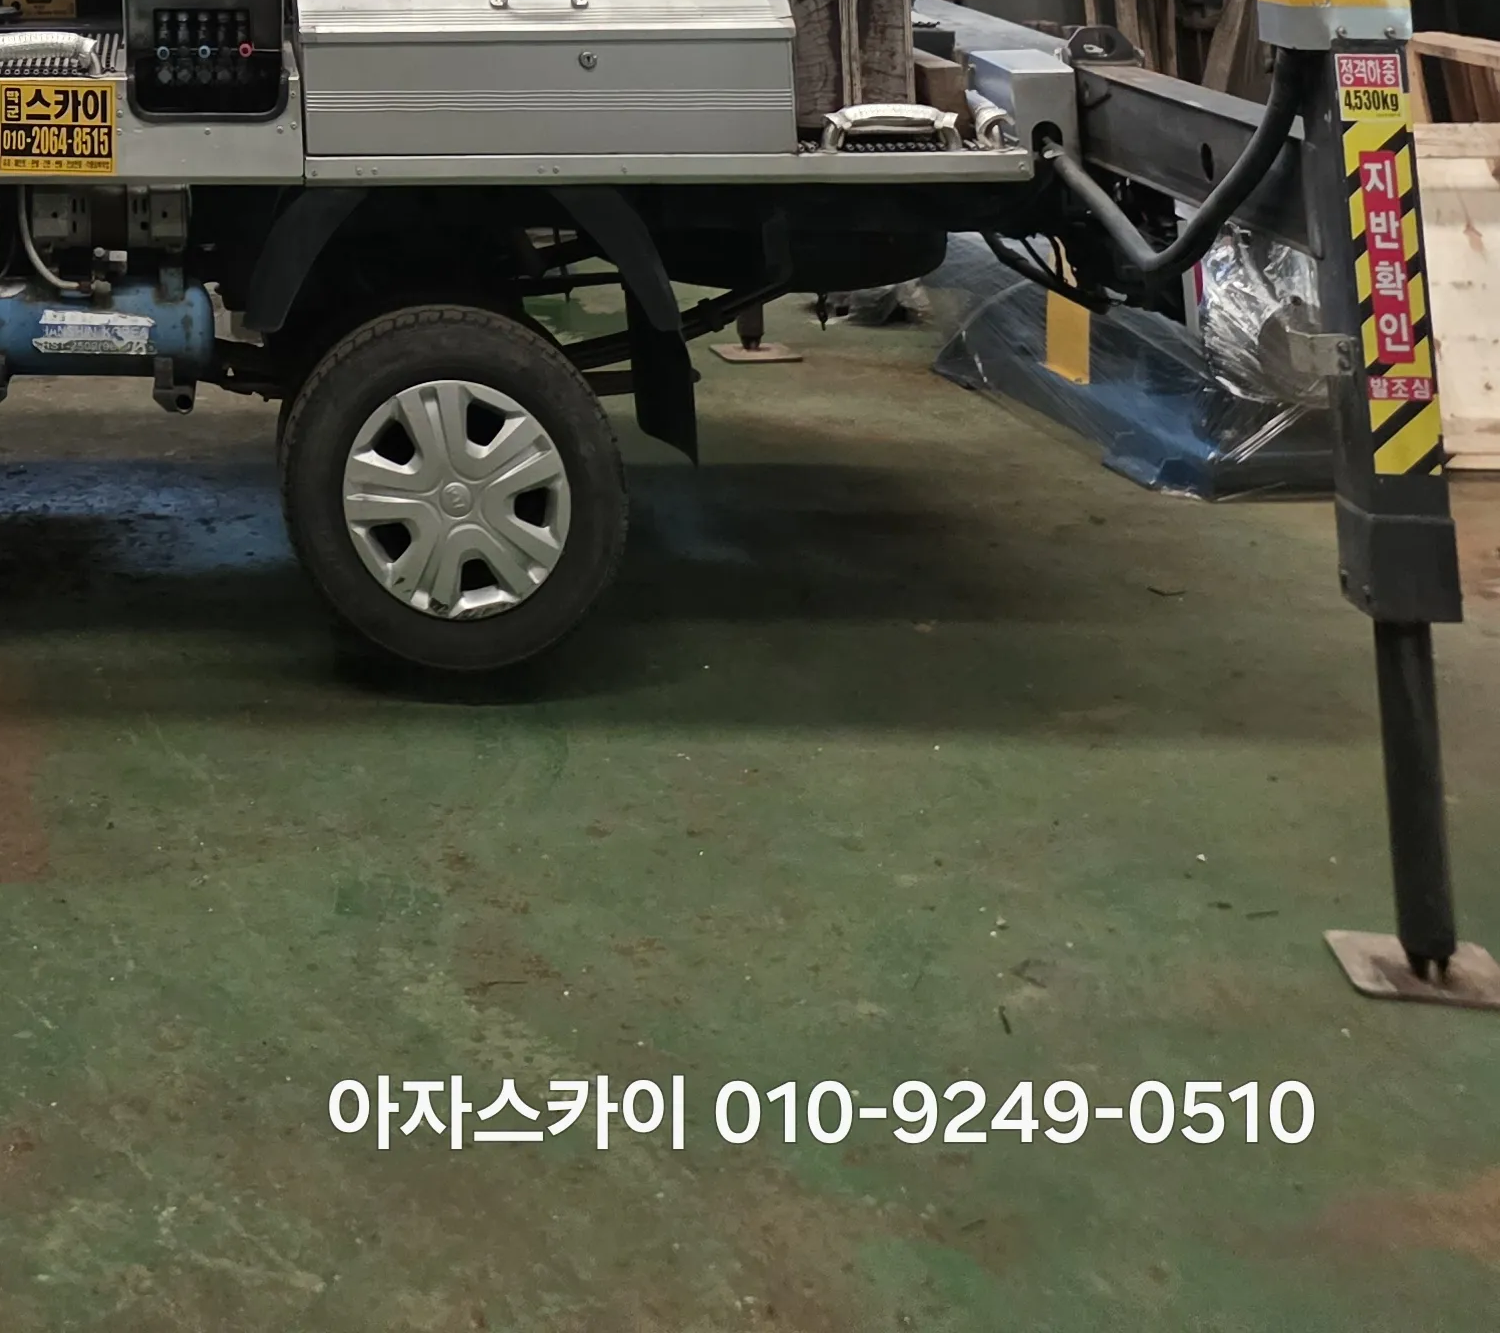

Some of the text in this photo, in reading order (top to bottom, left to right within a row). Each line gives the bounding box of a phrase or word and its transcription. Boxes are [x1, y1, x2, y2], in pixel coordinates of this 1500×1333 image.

[1340, 59, 1396, 85] 정격하중
[26, 89, 108, 123] 스카이
[1344, 89, 1399, 112] 4,530kg
[3, 126, 109, 155] 010-2064-8515
[1370, 377, 1432, 399] 발조심
